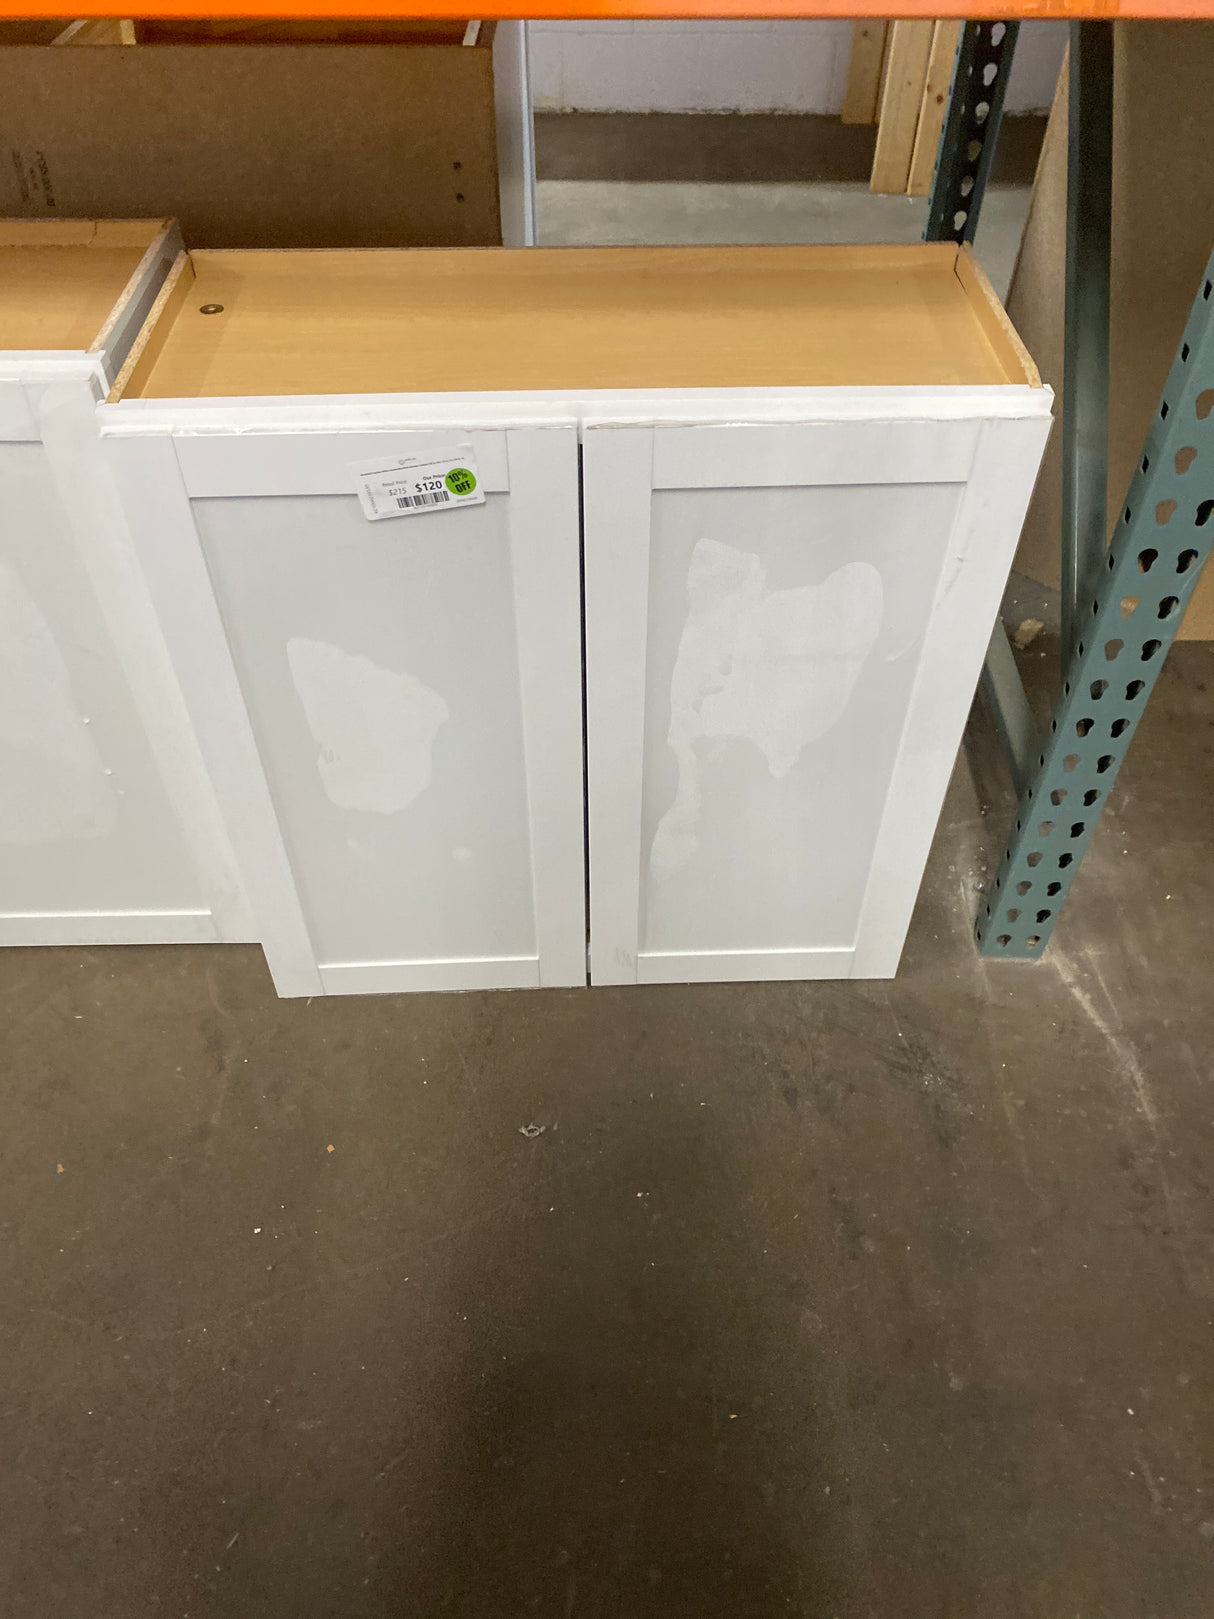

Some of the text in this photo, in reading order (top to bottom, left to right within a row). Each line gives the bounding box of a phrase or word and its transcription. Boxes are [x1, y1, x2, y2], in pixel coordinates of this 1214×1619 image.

[448, 468, 468, 483] 10%
[388, 487, 407, 496] $215
[415, 480, 443, 493] $120
[454, 480, 472, 493] OFF
